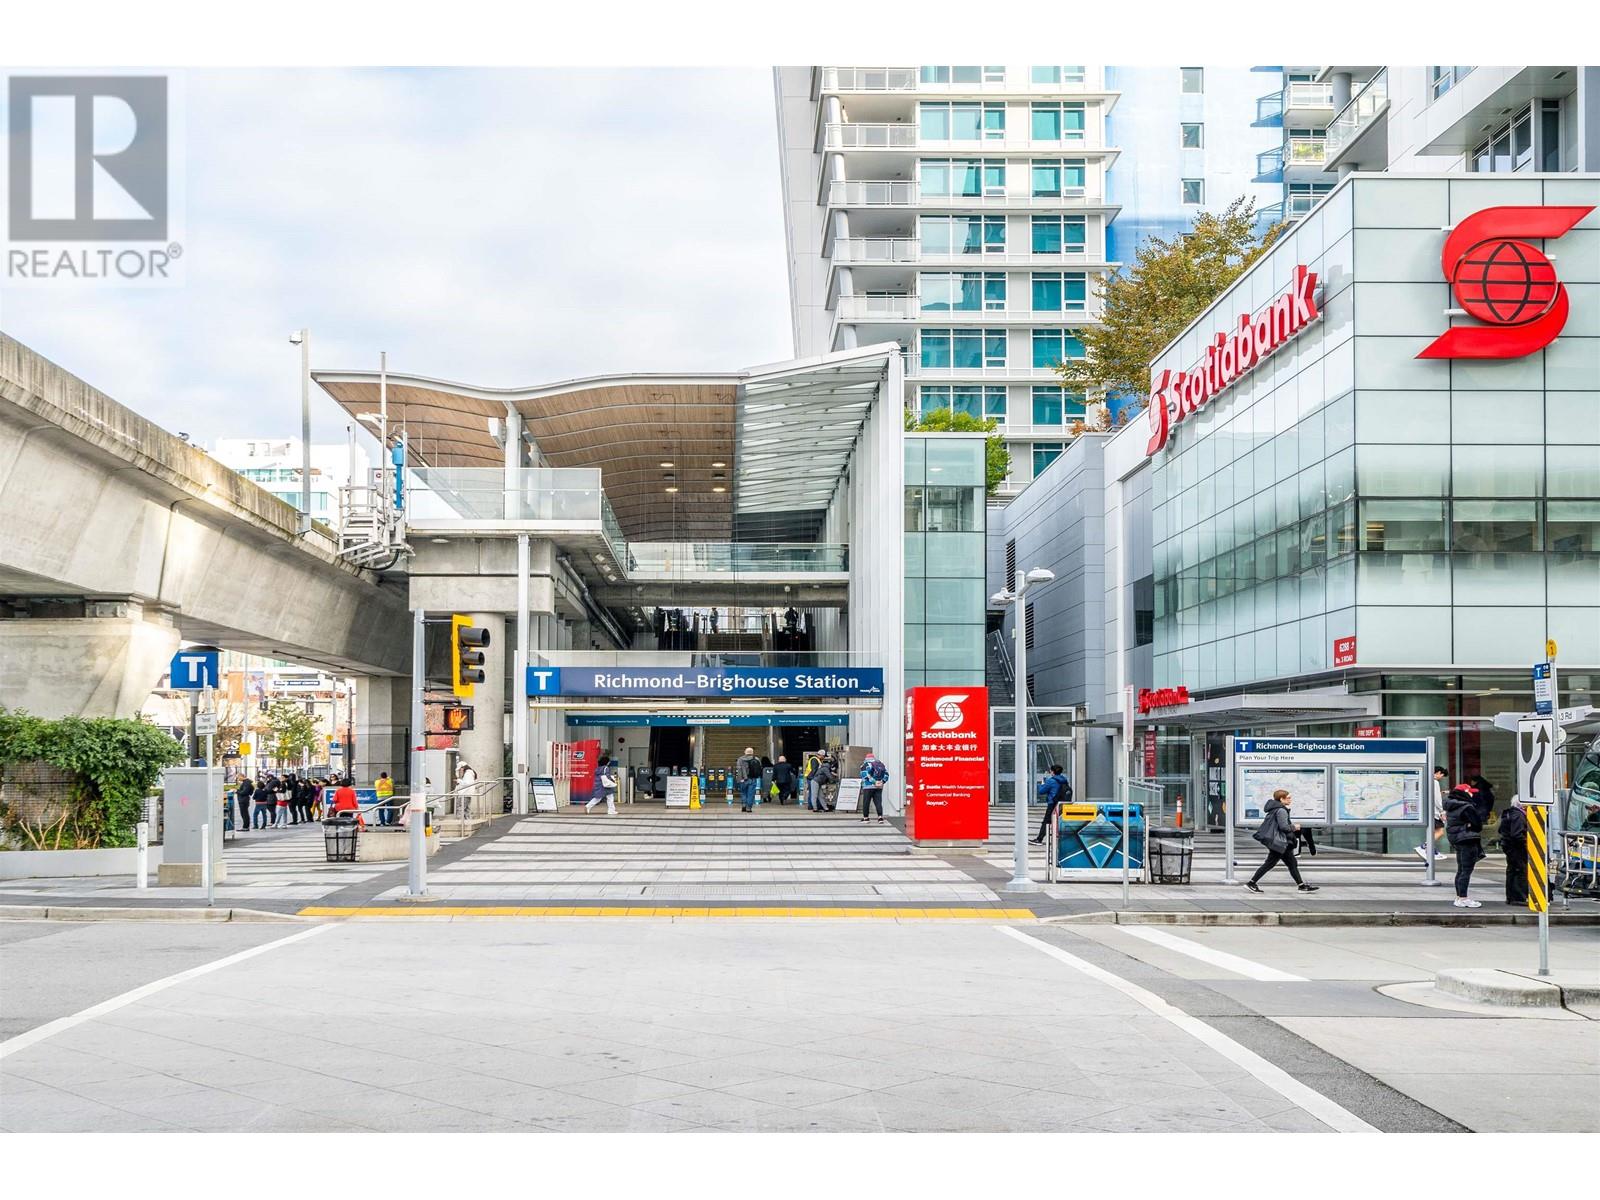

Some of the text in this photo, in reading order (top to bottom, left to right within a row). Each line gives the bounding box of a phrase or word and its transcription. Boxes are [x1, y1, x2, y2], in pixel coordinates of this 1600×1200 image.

[1170, 265, 1318, 425] Scotiabank
[533, 671, 553, 691] T
[794, 673, 859, 689] Station
[1565, 711, 1573, 720] Rd
[921, 731, 977, 739] Scotiabank
[1240, 742, 1248, 751] T
[1337, 742, 1365, 750] Station
